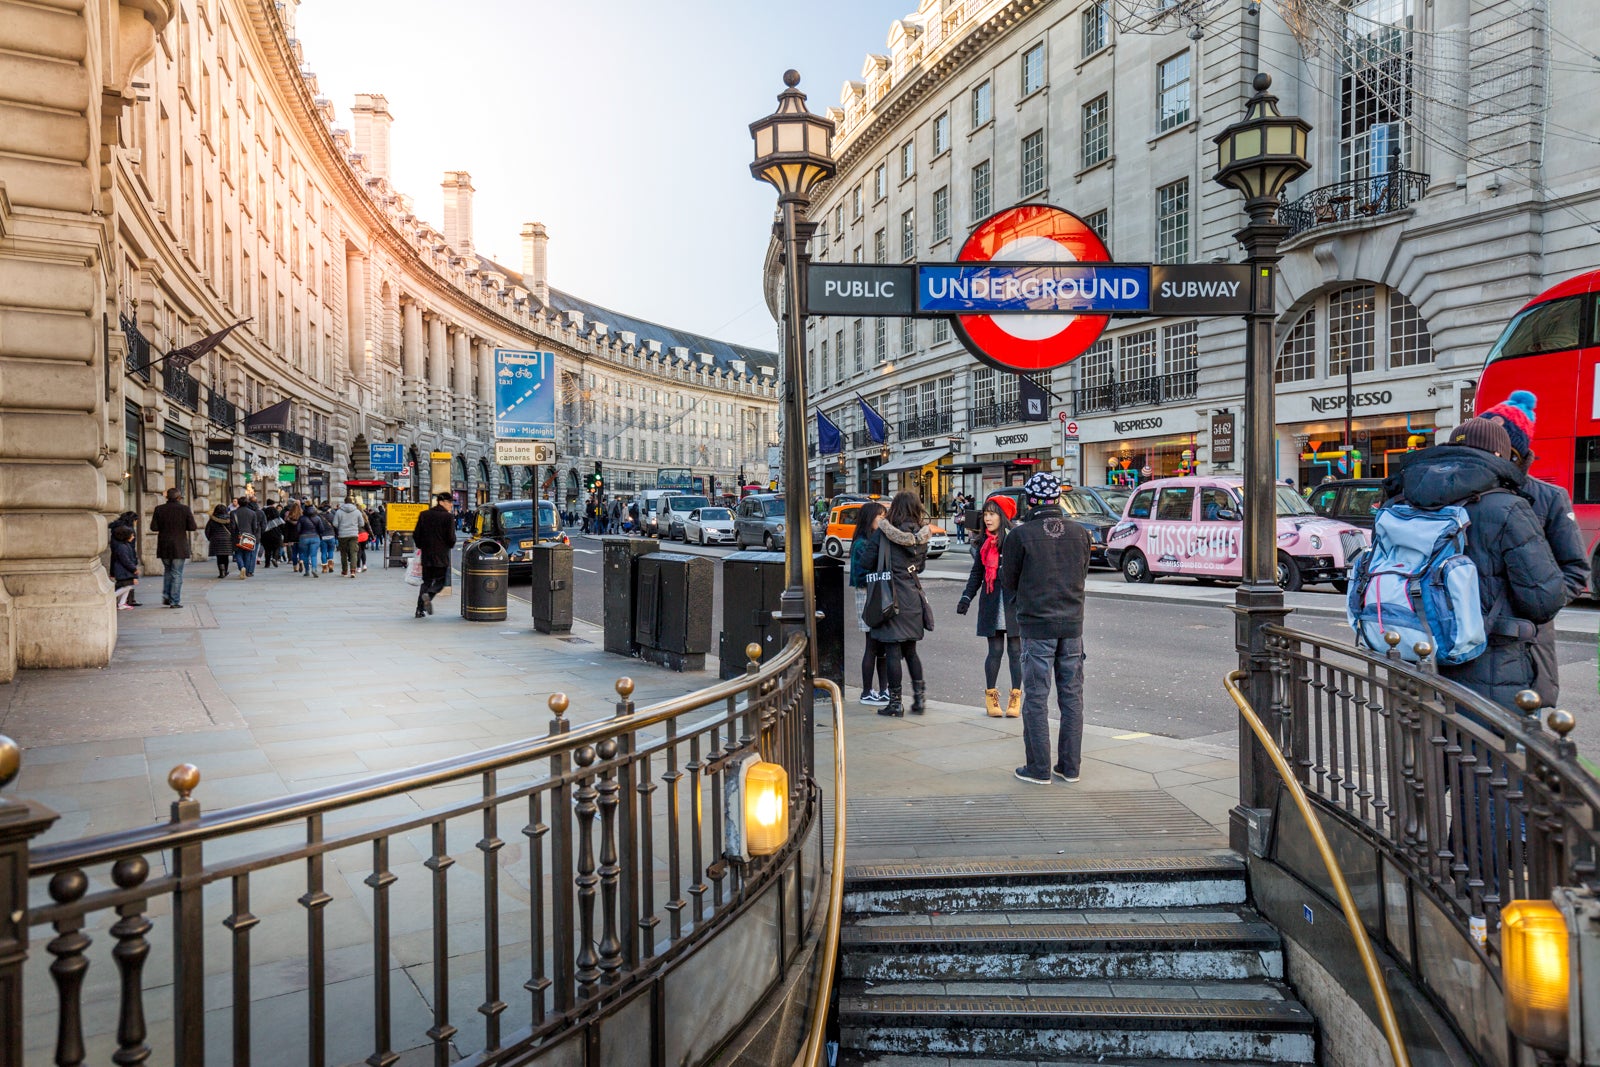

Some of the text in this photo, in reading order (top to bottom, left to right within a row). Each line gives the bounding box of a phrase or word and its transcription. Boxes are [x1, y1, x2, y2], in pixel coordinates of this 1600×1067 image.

[825, 280, 894, 298] PUBLIC
[928, 277, 1140, 299] UNDERGROUND
[1160, 281, 1241, 298] SUBWAY
[1427, 388, 1436, 398] 54
[1308, 390, 1393, 414] NESPRESSO
[497, 426, 516, 434] 11am
[522, 427, 554, 436] Midnight
[1113, 417, 1163, 434] NESPRESSO
[994, 433, 1029, 447] NESPRESSO
